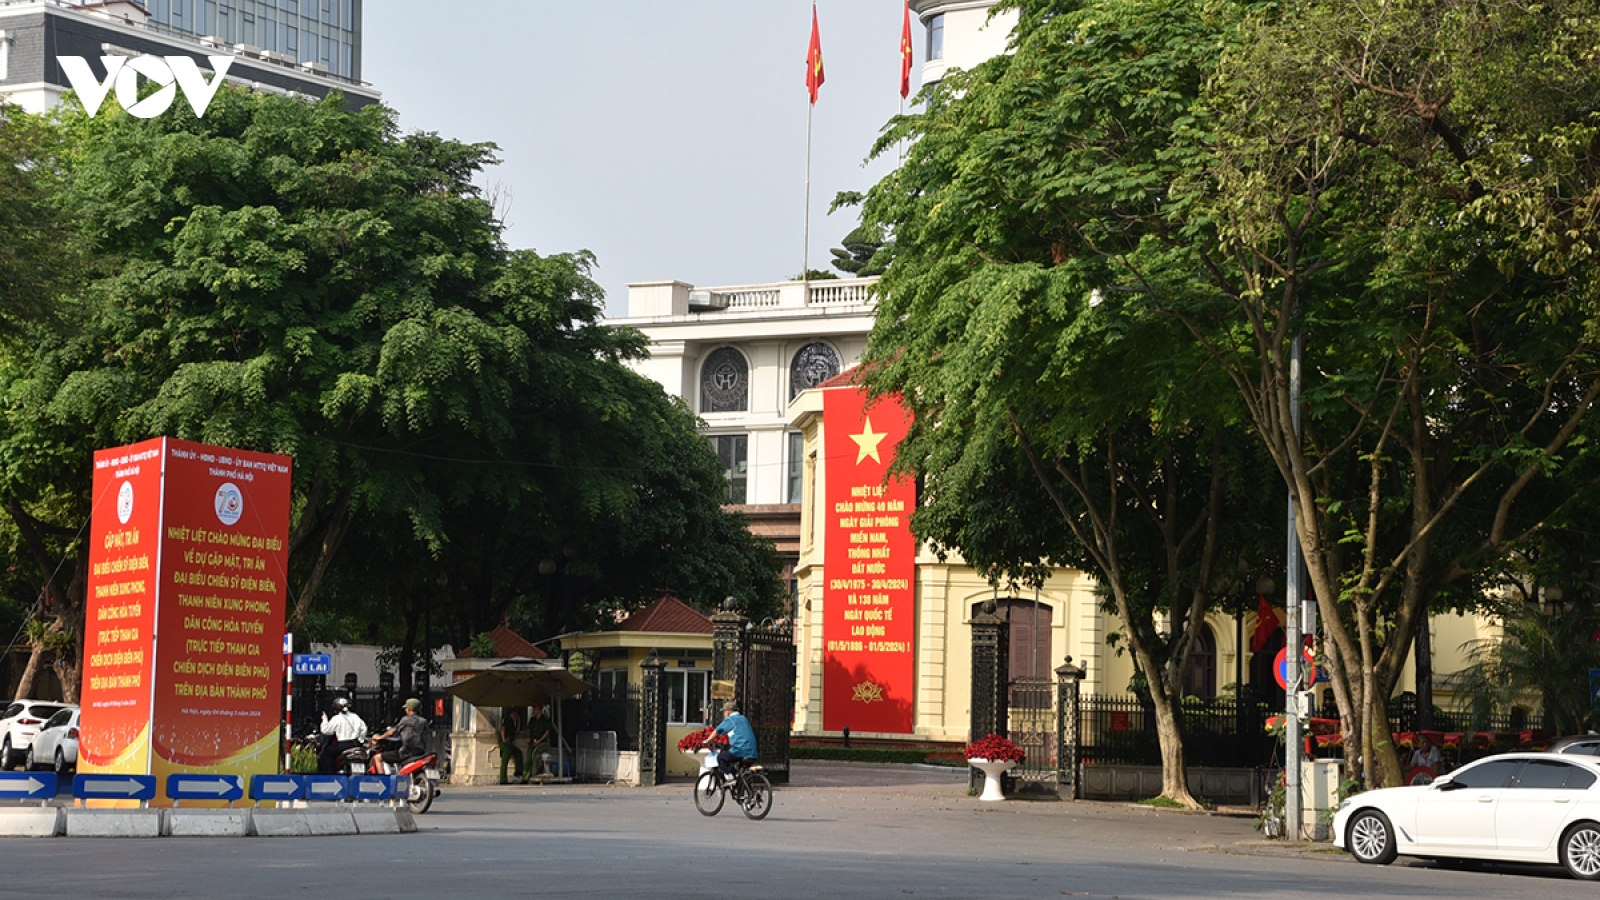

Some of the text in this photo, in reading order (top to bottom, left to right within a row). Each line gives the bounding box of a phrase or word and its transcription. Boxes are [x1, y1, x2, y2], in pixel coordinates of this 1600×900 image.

[852, 484, 871, 499] NHIỆT
[836, 500, 853, 512] CHÀO
[855, 499, 876, 512] MỪNG
[887, 499, 904, 511] NĂM
[840, 513, 899, 528] NGÀY GIẢI PHÓNG
[168, 525, 282, 551] NHIỆT LIỆT CHÀO MỪNG ĐẠI BIỂU
[851, 530, 868, 543] MIỀN
[848, 544, 890, 558] THỐNG NHẤT
[184, 547, 194, 564] VỀ
[195, 551, 208, 568] DỰ
[208, 551, 223, 569] GẶP
[243, 557, 254, 570] TRI
[255, 555, 265, 571] ÂN
[852, 561, 886, 574] ĐẤT NƯỚC
[174, 570, 188, 587] ĐẠI
[189, 569, 206, 585] BIỂU
[208, 571, 229, 588] CHIẾN
[231, 574, 240, 588] SỸ
[241, 575, 258, 593] ĐIỆN
[830, 579, 865, 590] (30/4/1975
[872, 579, 908, 590] 30/4/2024)
[178, 594, 203, 608] THANH
[205, 594, 222, 609] NIÊN
[224, 598, 243, 611] XUNG
[848, 592, 857, 605] VÀ
[872, 592, 889, 605] NĂM
[844, 607, 893, 621] NGÀY QUỐC TẾ
[184, 614, 200, 629] DÂN
[202, 616, 222, 631] CÔNG
[241, 618, 264, 634] TUYẾN
[852, 624, 885, 638] LAO ĐỘNG
[186, 637, 260, 656] (TRỰC TIẾP THAM GIA
[173, 658, 270, 681] CHIẾN DỊCH ĐIỆN BIÊN PHỦ)
[296, 662, 326, 671] LÊ LAI
[174, 681, 268, 700] TRÊN ĐỊA BÀN THÀNH PHỐ
